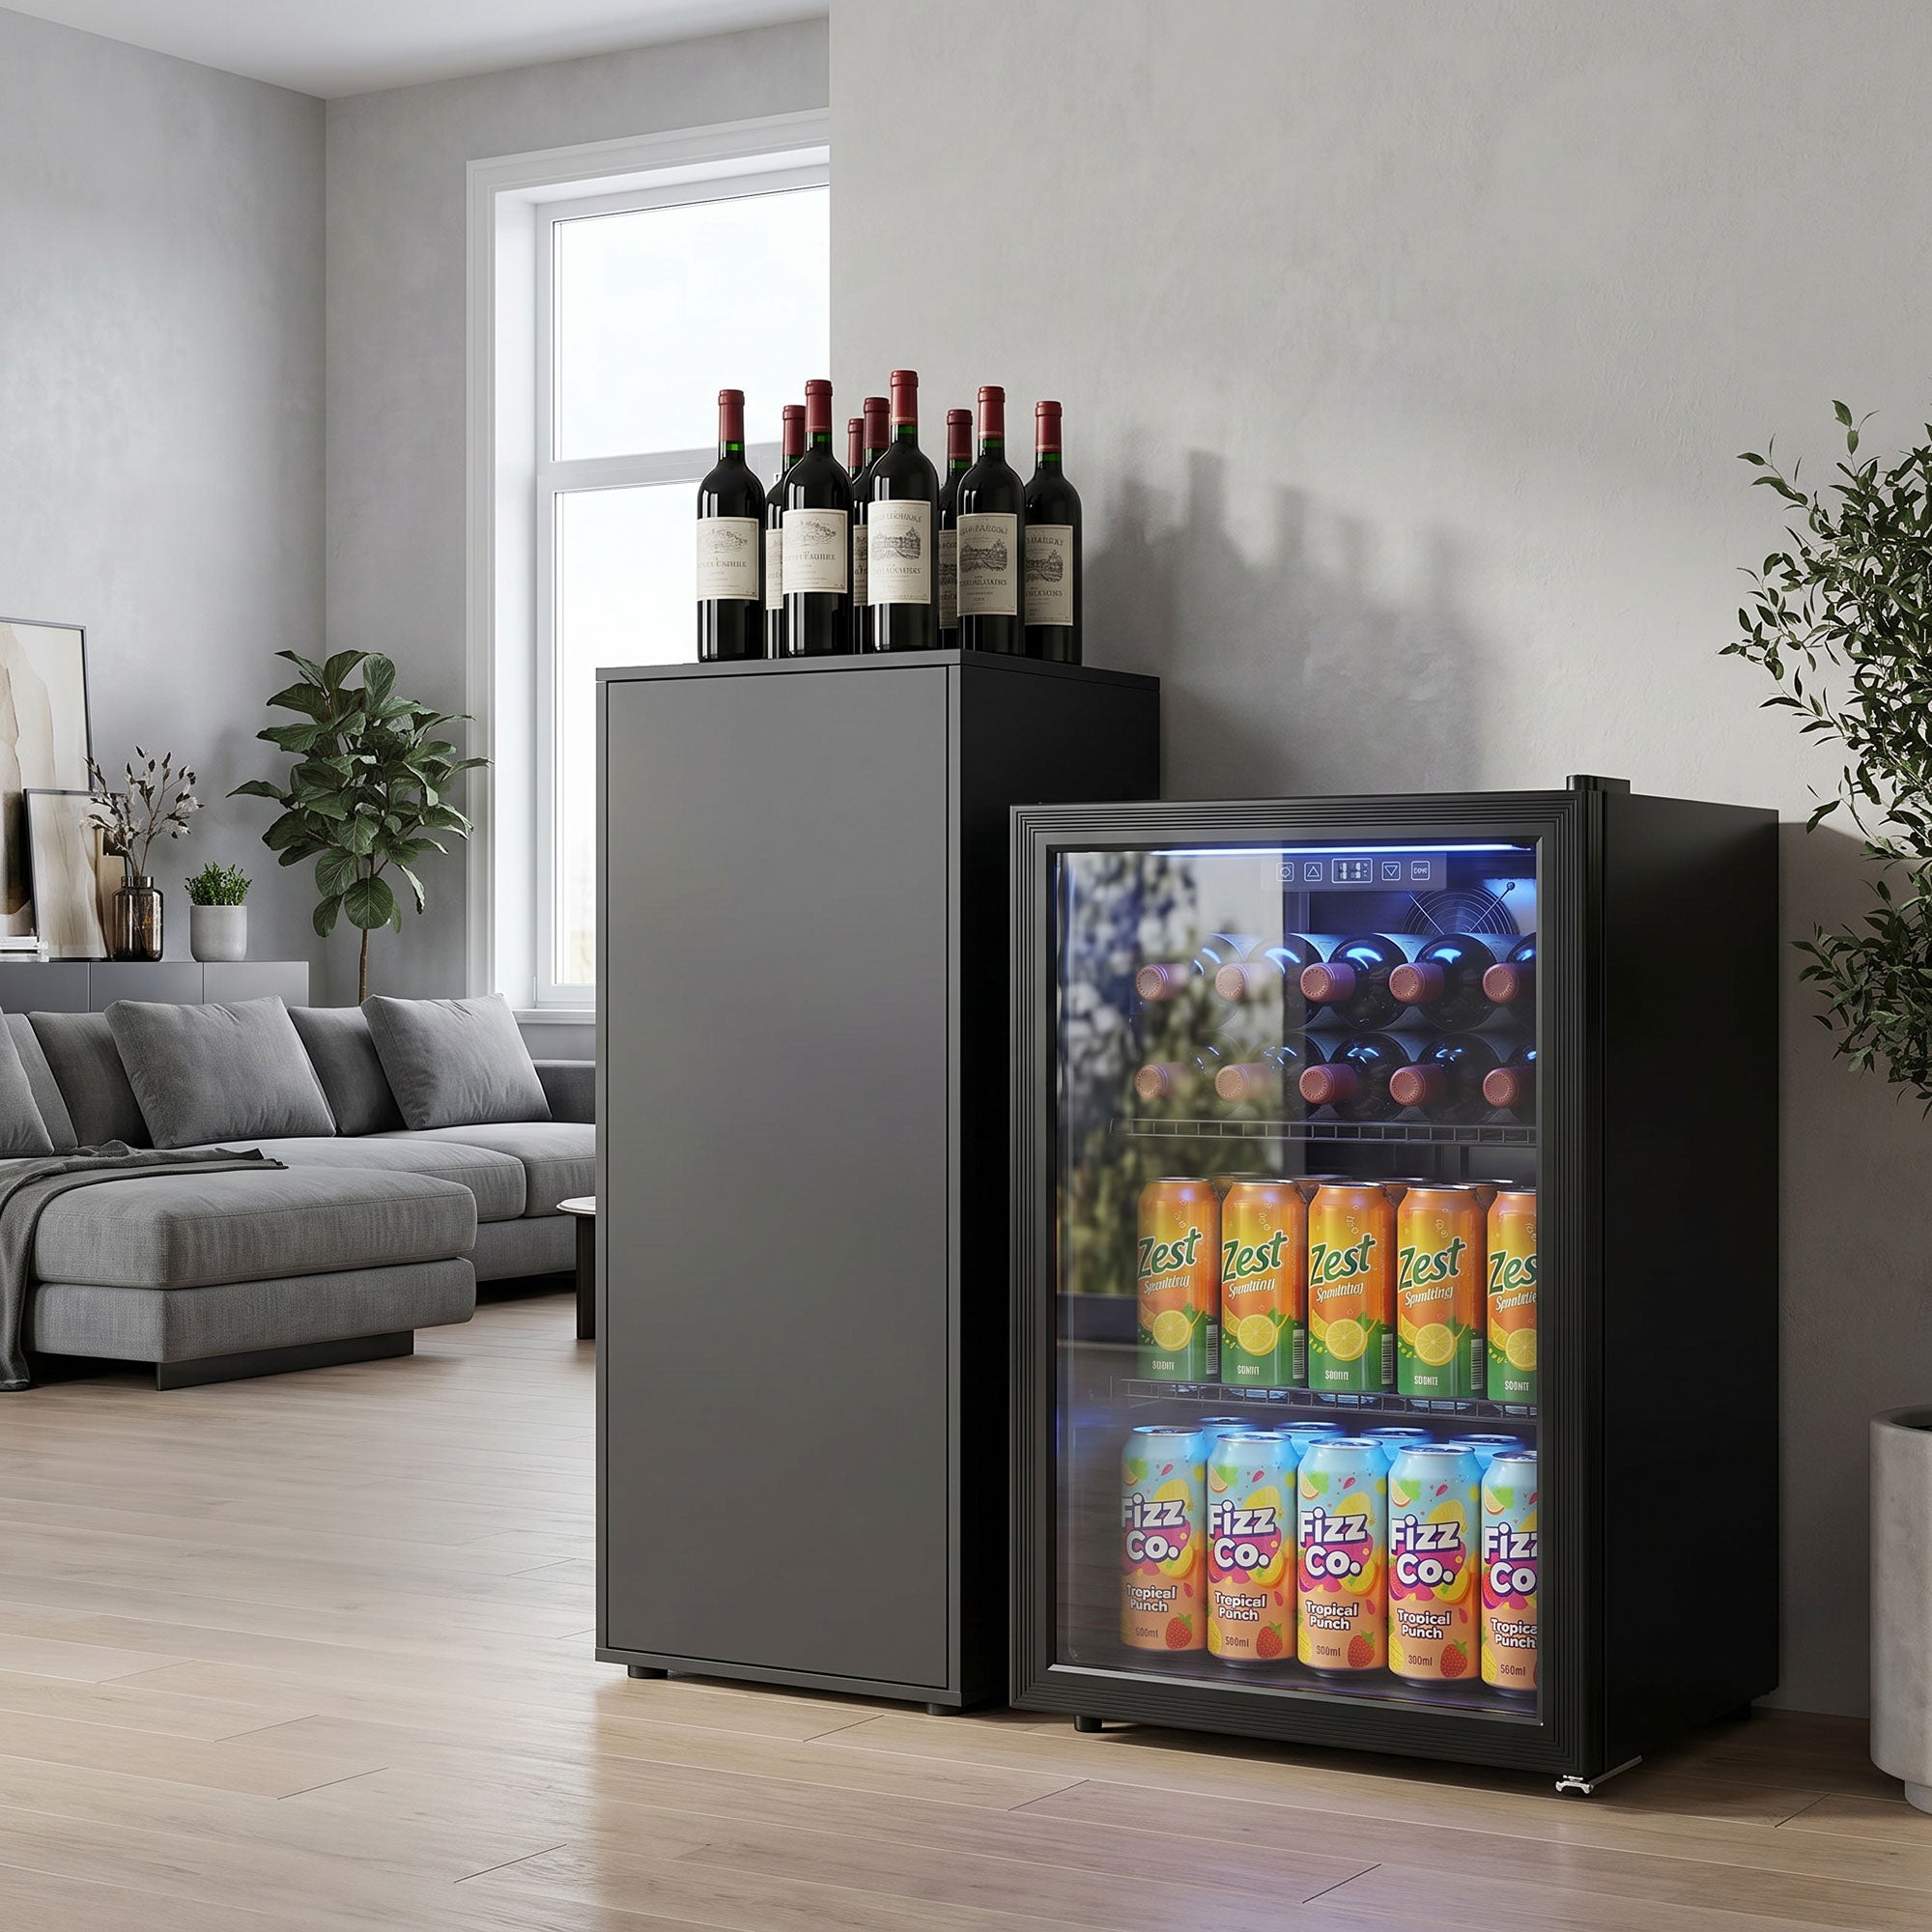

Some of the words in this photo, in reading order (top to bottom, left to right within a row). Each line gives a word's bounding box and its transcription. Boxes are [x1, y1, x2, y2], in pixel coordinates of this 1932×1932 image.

[1137, 1227, 1203, 1280] Zest
[1222, 1229, 1289, 1284] Zest
[1309, 1232, 1378, 1289] Zest
[1398, 1236, 1467, 1293] Zest
[1122, 1493, 1185, 1529] Fizz
[1209, 1500, 1276, 1536] Fizz
[1300, 1507, 1368, 1544] Fizz
[1125, 1529, 1179, 1561] Co.
[1391, 1515, 1460, 1552] Fizz
[1214, 1537, 1270, 1569] Co.
[1305, 1546, 1361, 1577] Co.
[1396, 1552, 1454, 1585] Co.
[1130, 1599, 1169, 1613] Punch
[1310, 1616, 1350, 1631] Punch
[1402, 1625, 1444, 1640] Punch
[1225, 1635, 1249, 1648] 500ml
[1494, 1634, 1537, 1650] Punch
